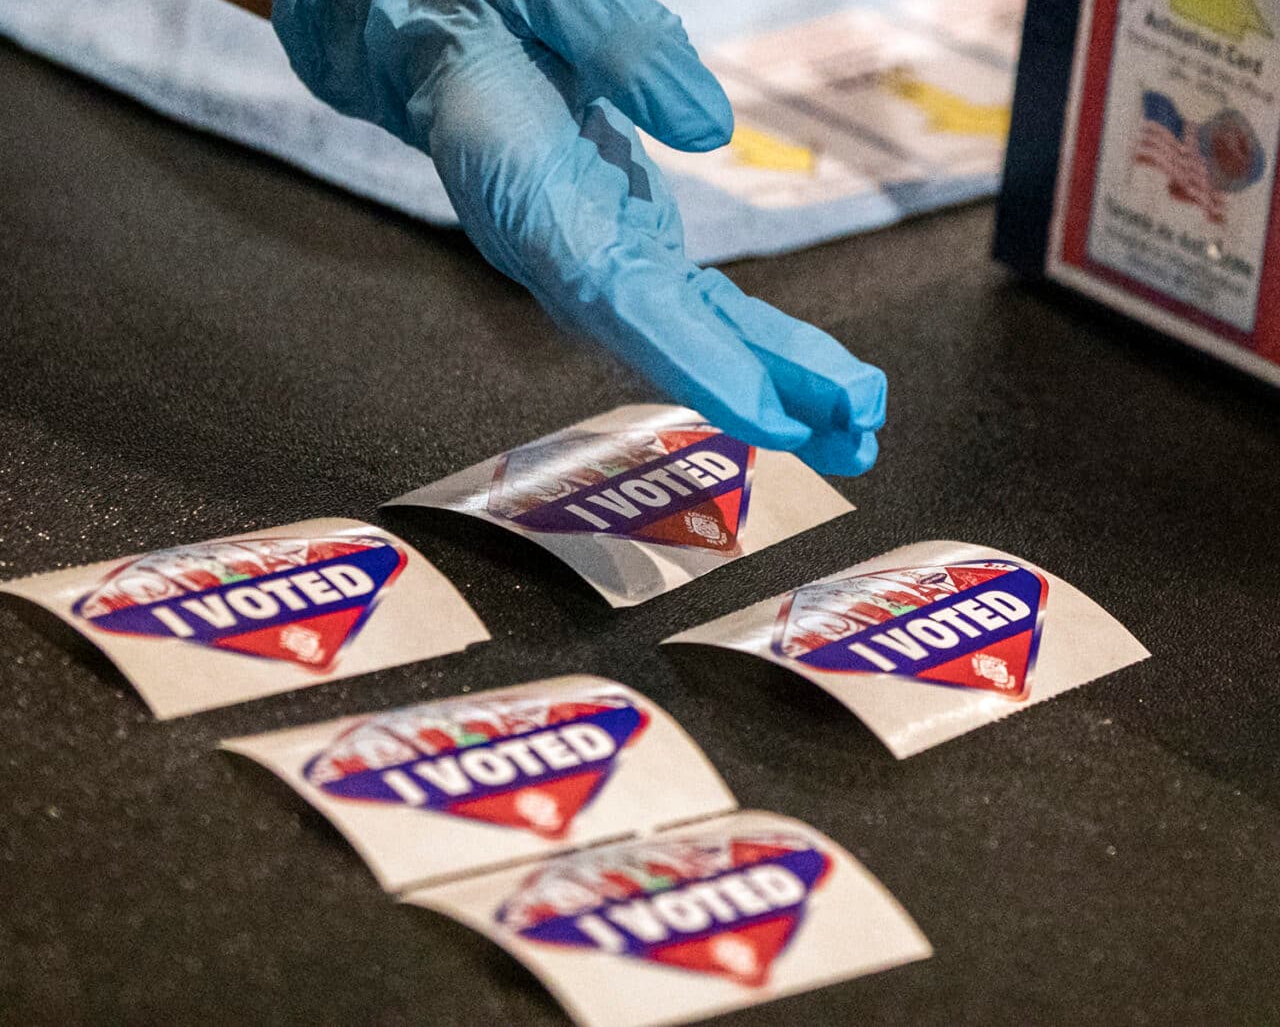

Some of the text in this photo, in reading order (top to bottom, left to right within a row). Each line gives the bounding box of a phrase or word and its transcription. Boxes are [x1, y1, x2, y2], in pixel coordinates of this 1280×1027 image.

[564, 450, 741, 530] I VOTED
[151, 563, 376, 639] I VOTED
[848, 589, 1032, 673] I VOTED
[383, 722, 618, 807] I VOTED
[576, 863, 807, 955] I VOTED
